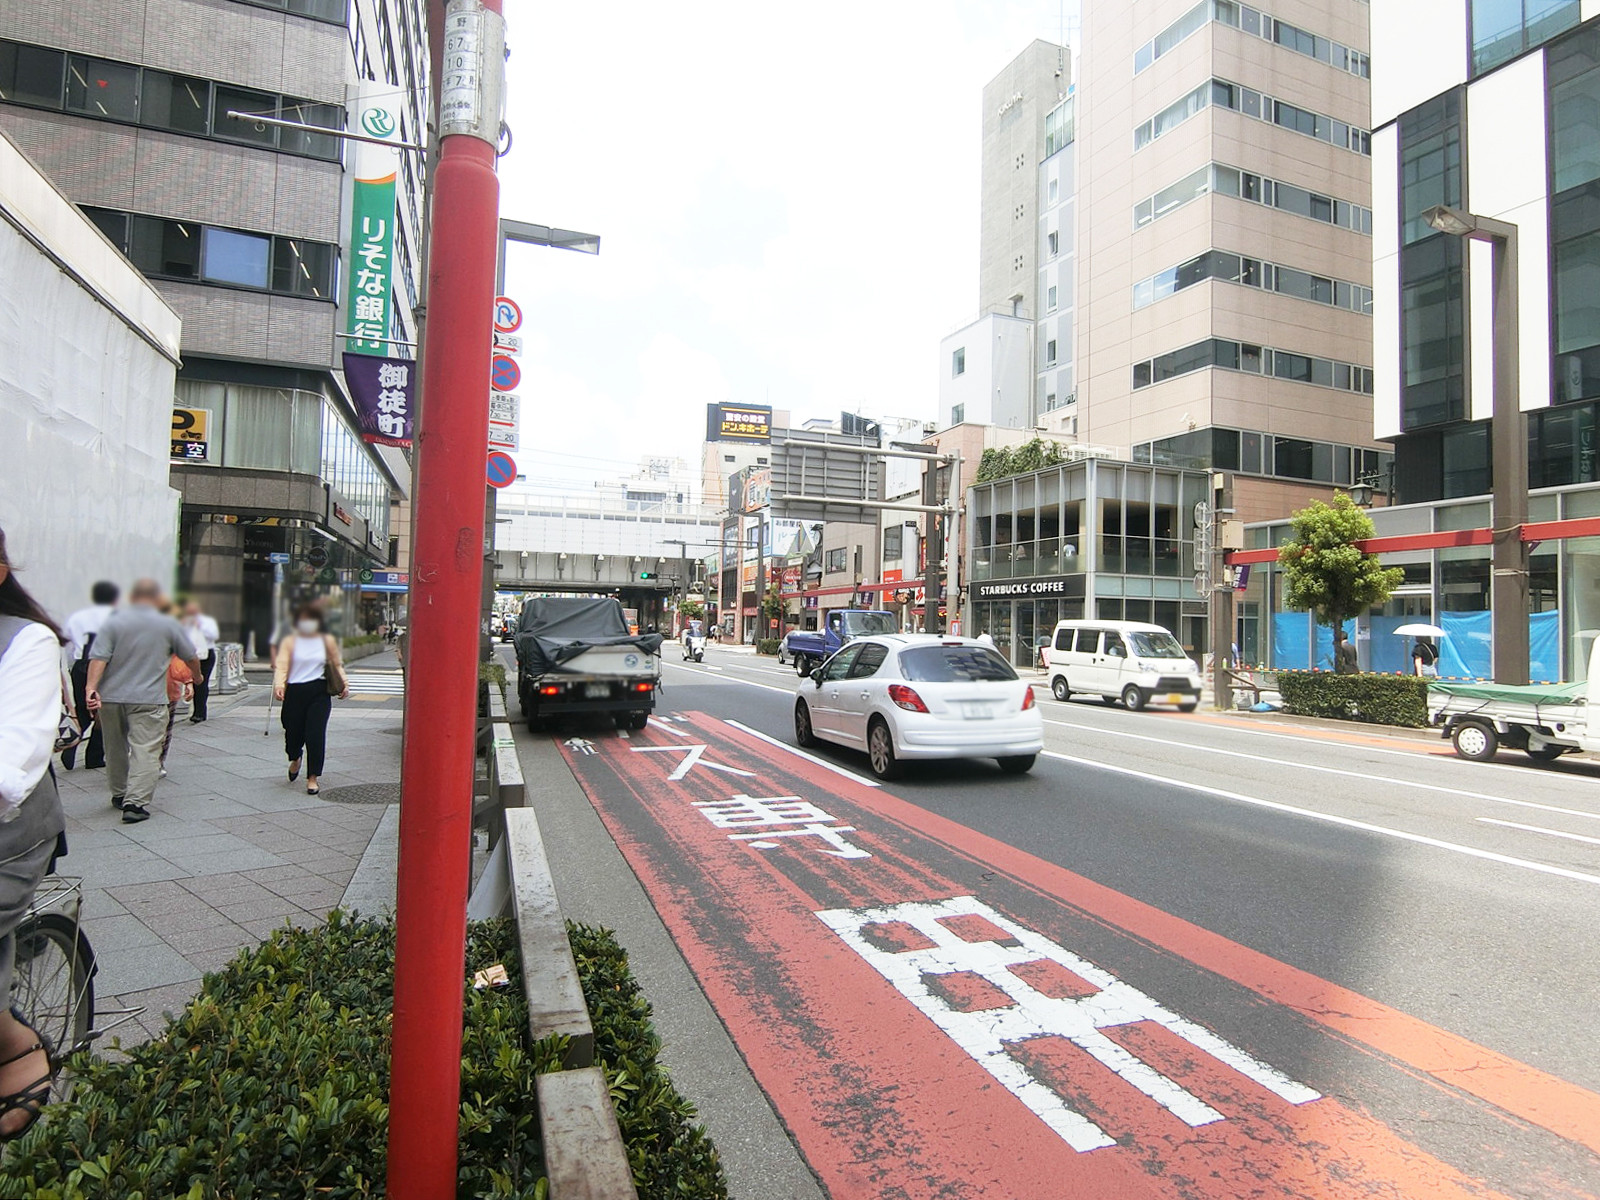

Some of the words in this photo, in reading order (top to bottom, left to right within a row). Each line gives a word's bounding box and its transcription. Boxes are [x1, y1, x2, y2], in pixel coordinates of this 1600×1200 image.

[354, 216, 388, 349] りそな銀行
[376, 362, 409, 438] 御徒町
[186, 442, 206, 458] 空
[980, 583, 1028, 596] STARBUCKS
[1030, 581, 1064, 593] COFFEE
